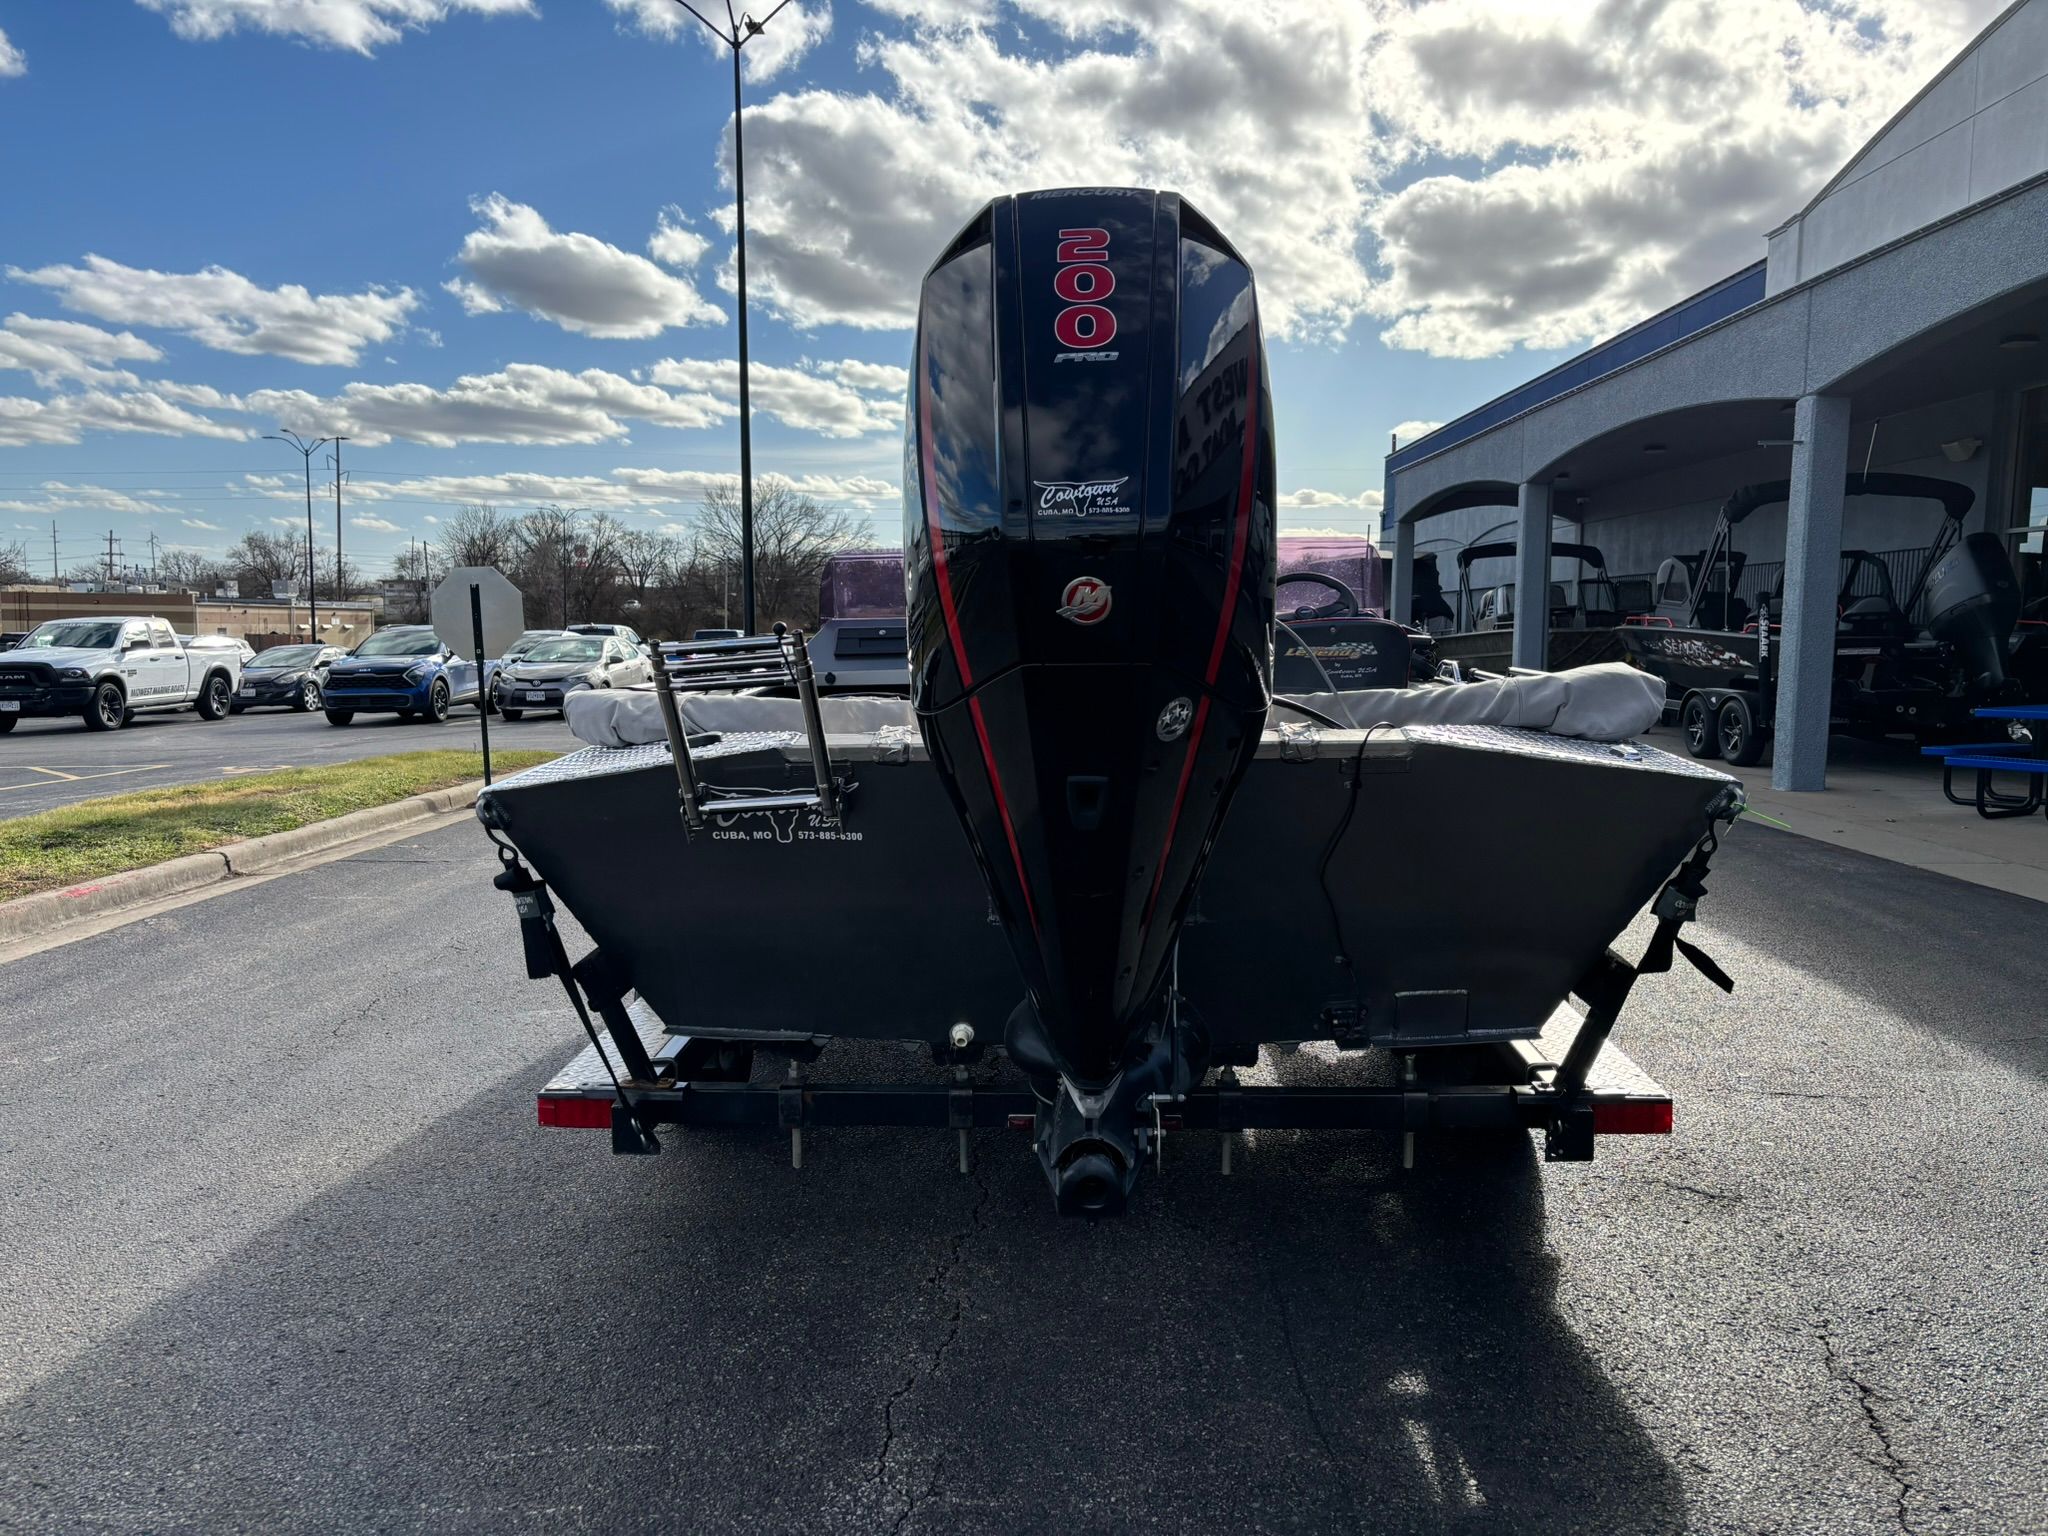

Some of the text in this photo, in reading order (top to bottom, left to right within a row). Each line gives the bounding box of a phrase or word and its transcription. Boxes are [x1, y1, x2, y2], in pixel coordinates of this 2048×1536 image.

[1030, 188, 1141, 200] MERCURY
[1054, 228, 1117, 349] 200
[1054, 352, 1119, 363] PRO
[1040, 484, 1120, 508] Cowtown
[1096, 496, 1119, 506] USA
[130, 687, 152, 697] MIDWEST
[152, 686, 171, 695] MARINE
[712, 831, 863, 841] CUBA, MO 573-885-6300
